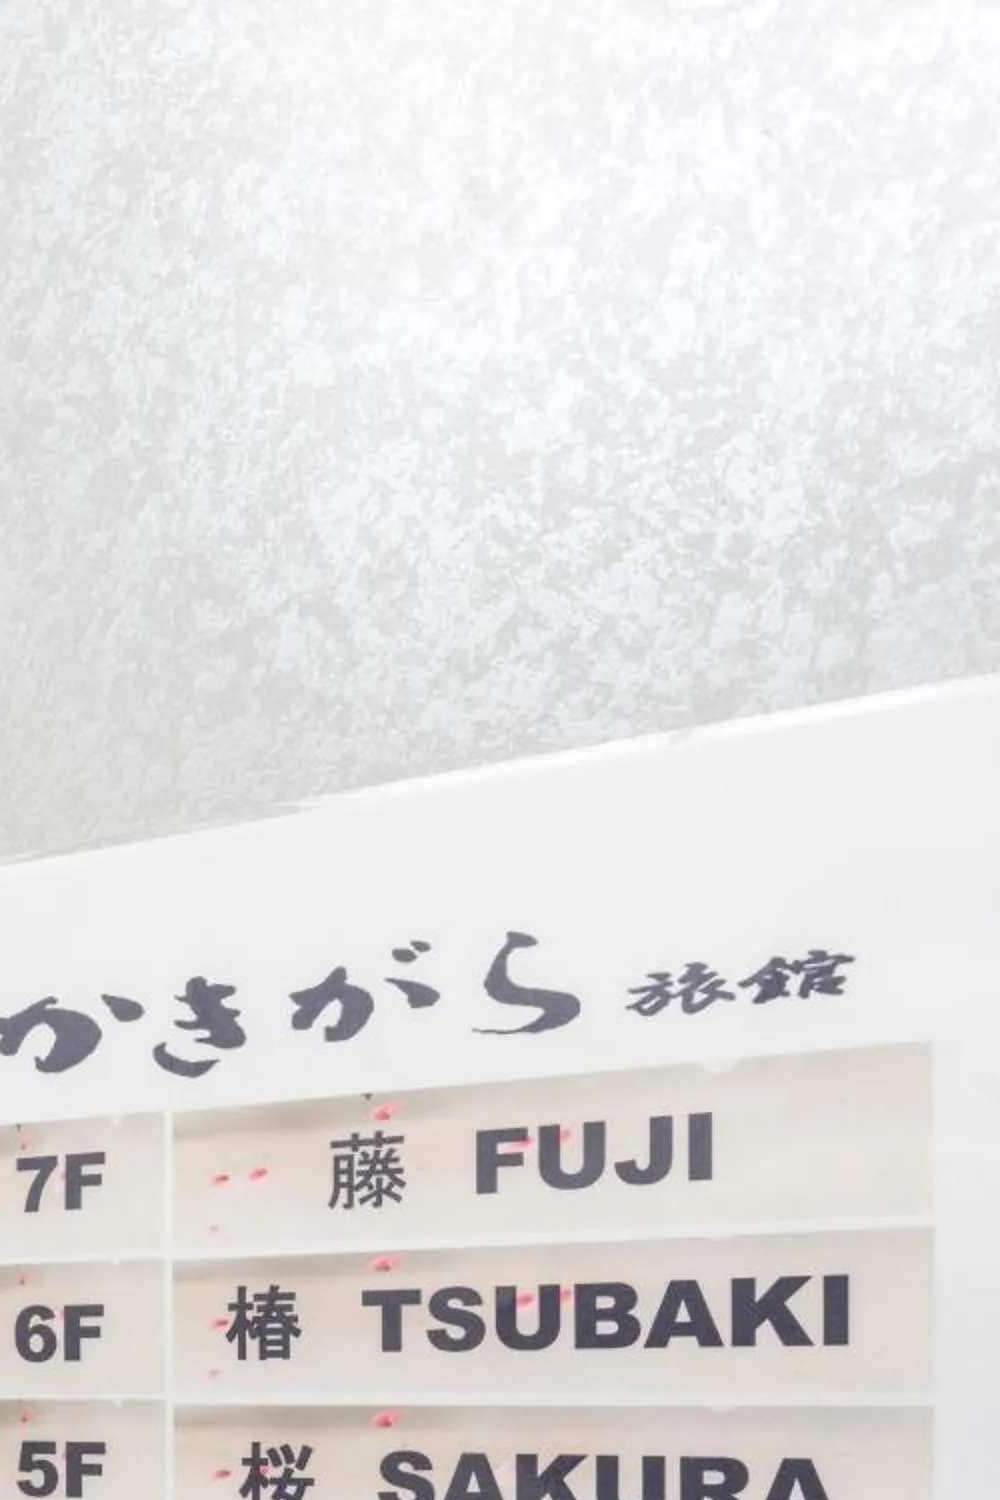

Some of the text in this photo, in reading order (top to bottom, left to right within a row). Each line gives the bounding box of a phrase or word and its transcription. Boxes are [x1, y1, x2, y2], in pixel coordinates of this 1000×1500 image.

[16, 1112, 713, 1213] 7F 藤 FUJI
[14, 1274, 849, 1363] 6F 椿 TSUBAKI
[17, 1440, 107, 1499] 5F
